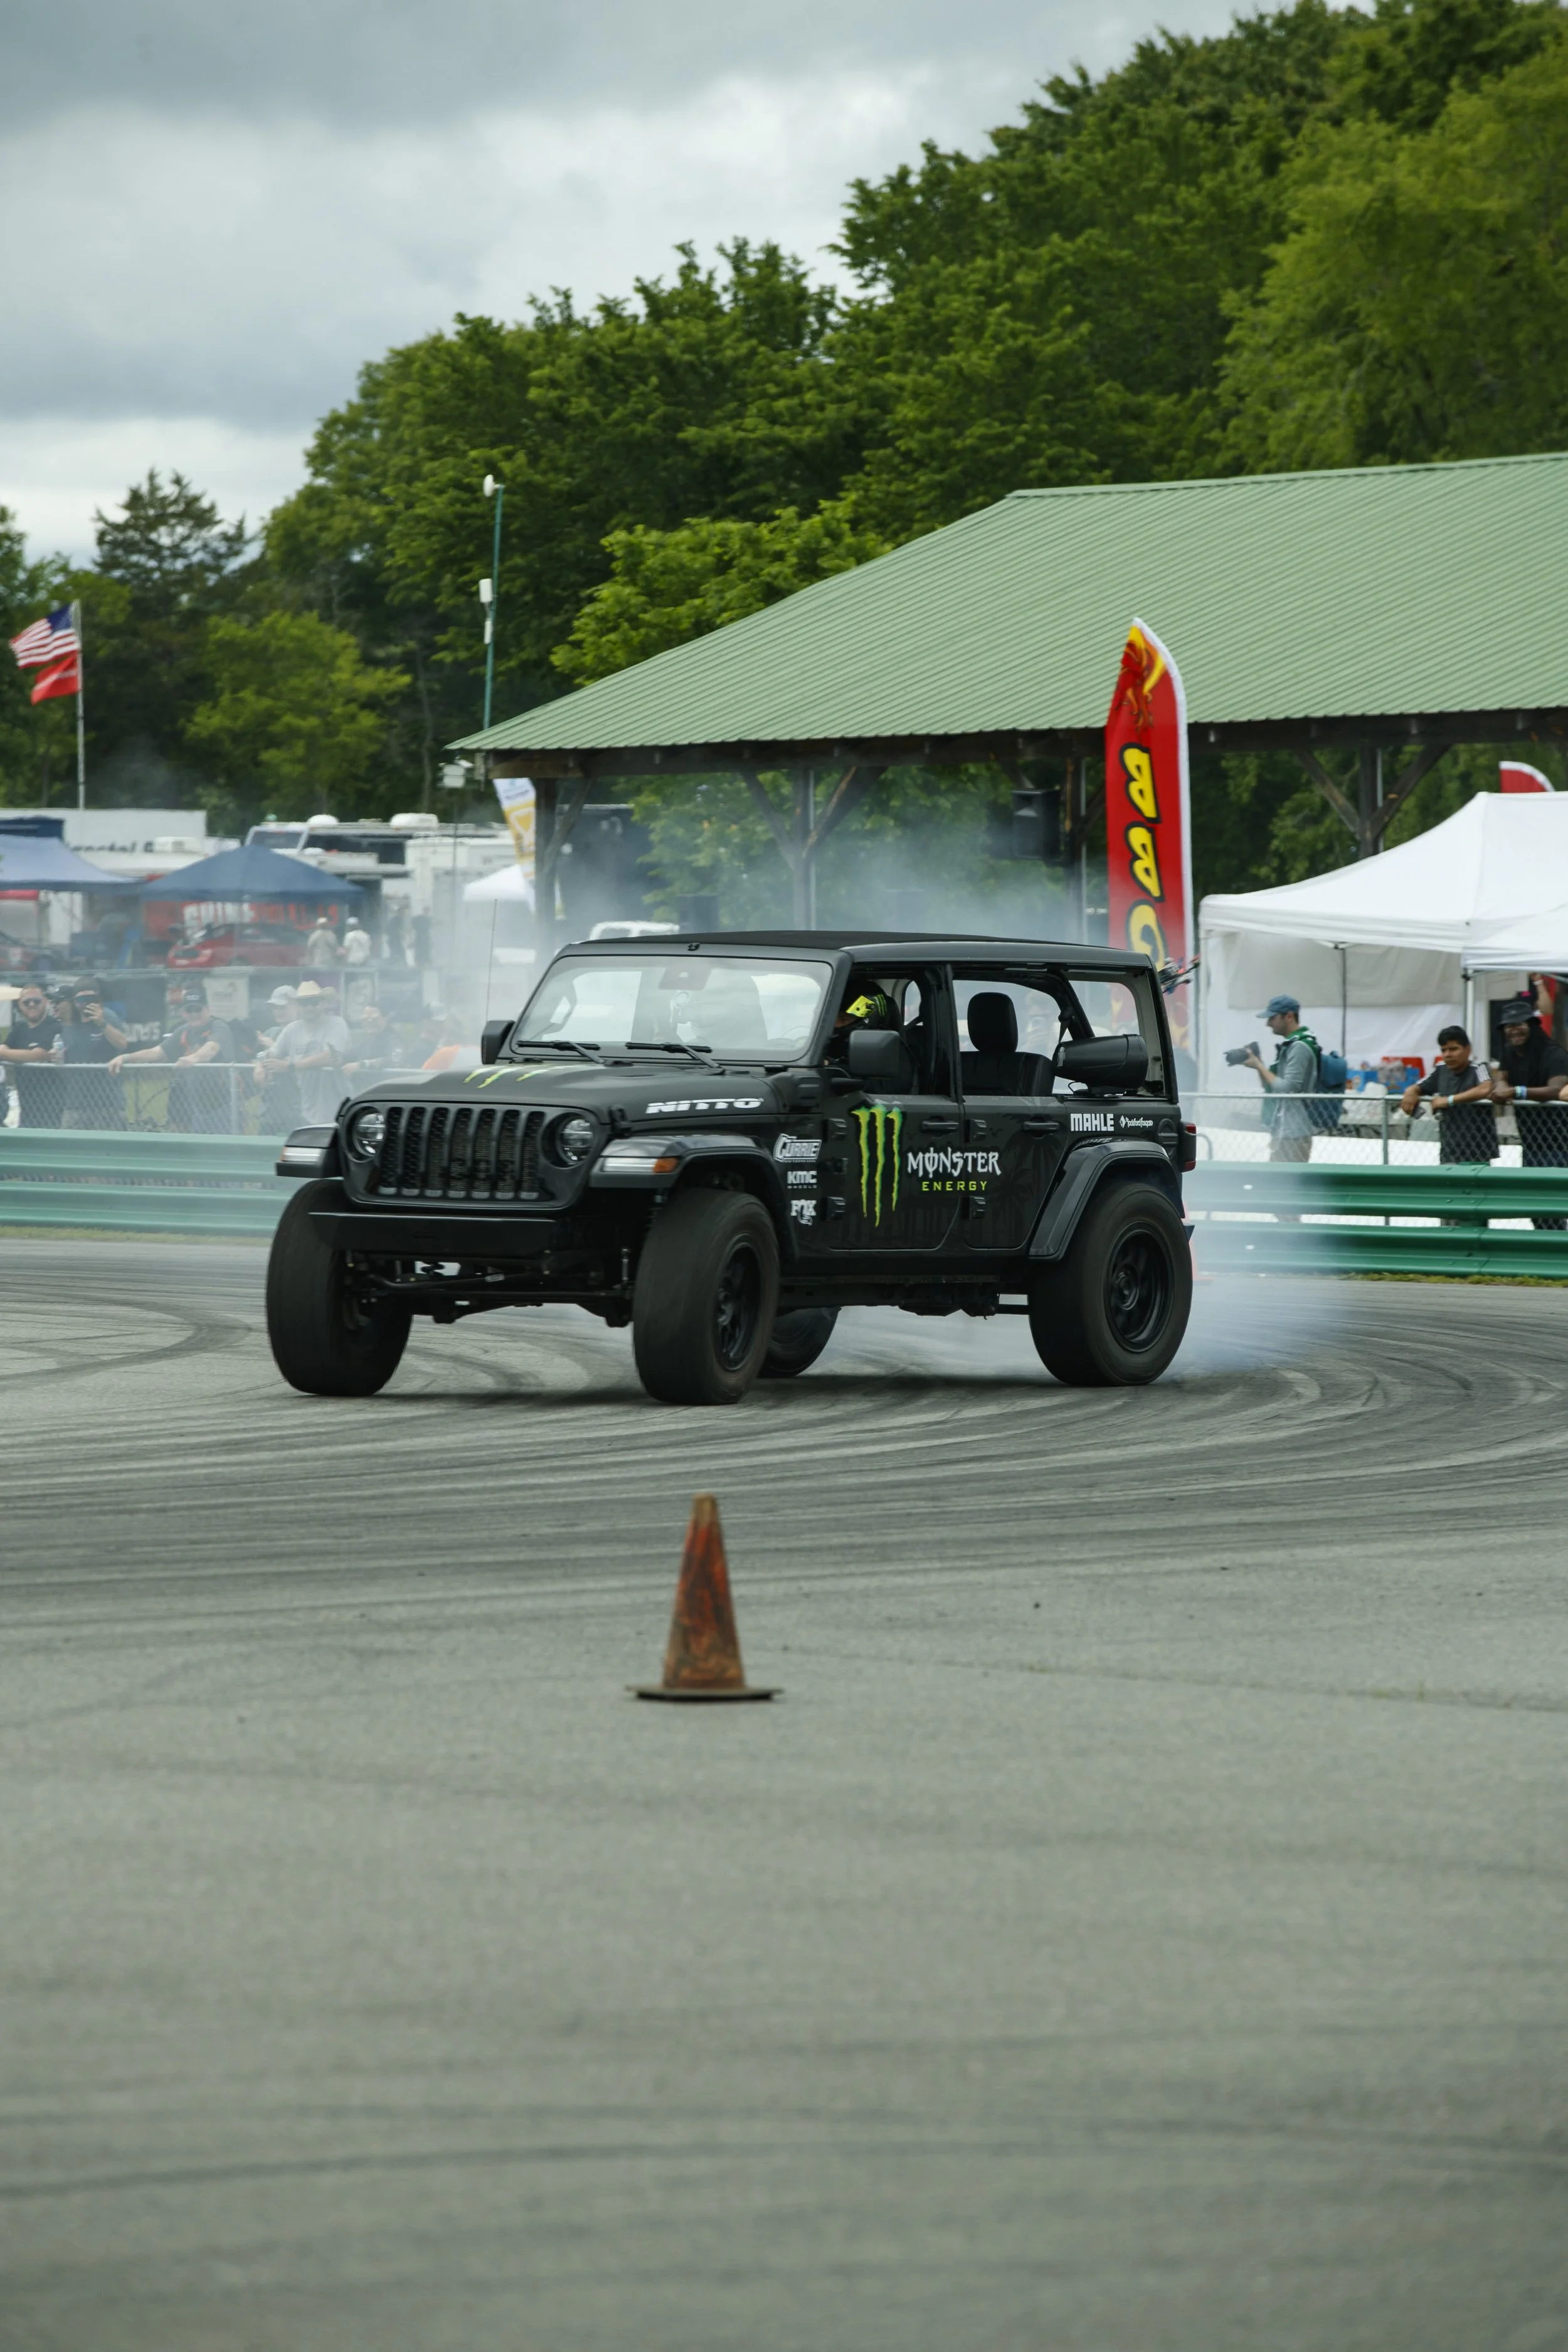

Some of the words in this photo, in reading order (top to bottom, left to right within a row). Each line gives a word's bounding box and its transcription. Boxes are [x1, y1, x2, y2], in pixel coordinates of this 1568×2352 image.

[645, 1098, 761, 1114] NITTO
[1070, 1113, 1115, 1131] MAHLE
[907, 1147, 1002, 1178] MONSTER
[787, 1171, 817, 1184] KMC
[922, 1181, 987, 1191] ENERGY
[790, 1199, 817, 1221] FOX
